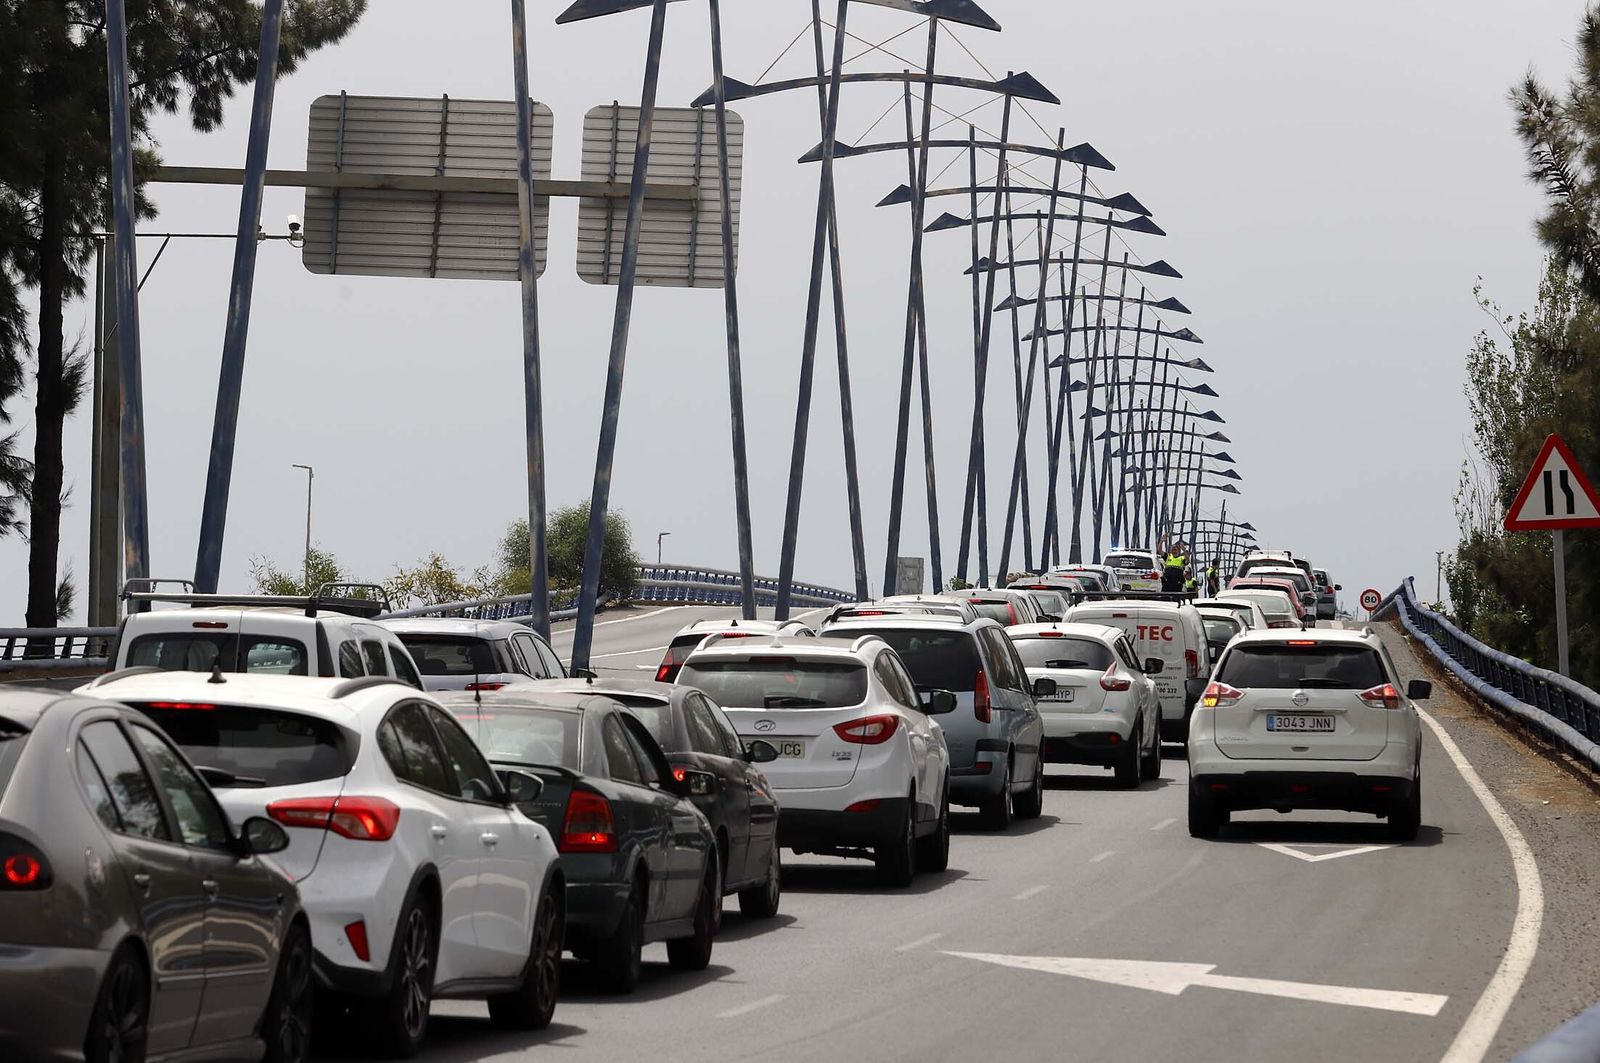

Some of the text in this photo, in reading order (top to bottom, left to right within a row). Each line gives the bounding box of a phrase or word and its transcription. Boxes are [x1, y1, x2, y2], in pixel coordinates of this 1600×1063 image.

[1136, 626, 1173, 641] TEC
[1054, 690, 1071, 699] HYP
[1276, 717, 1330, 728] 3043 JNN
[777, 743, 801, 756] JCG
